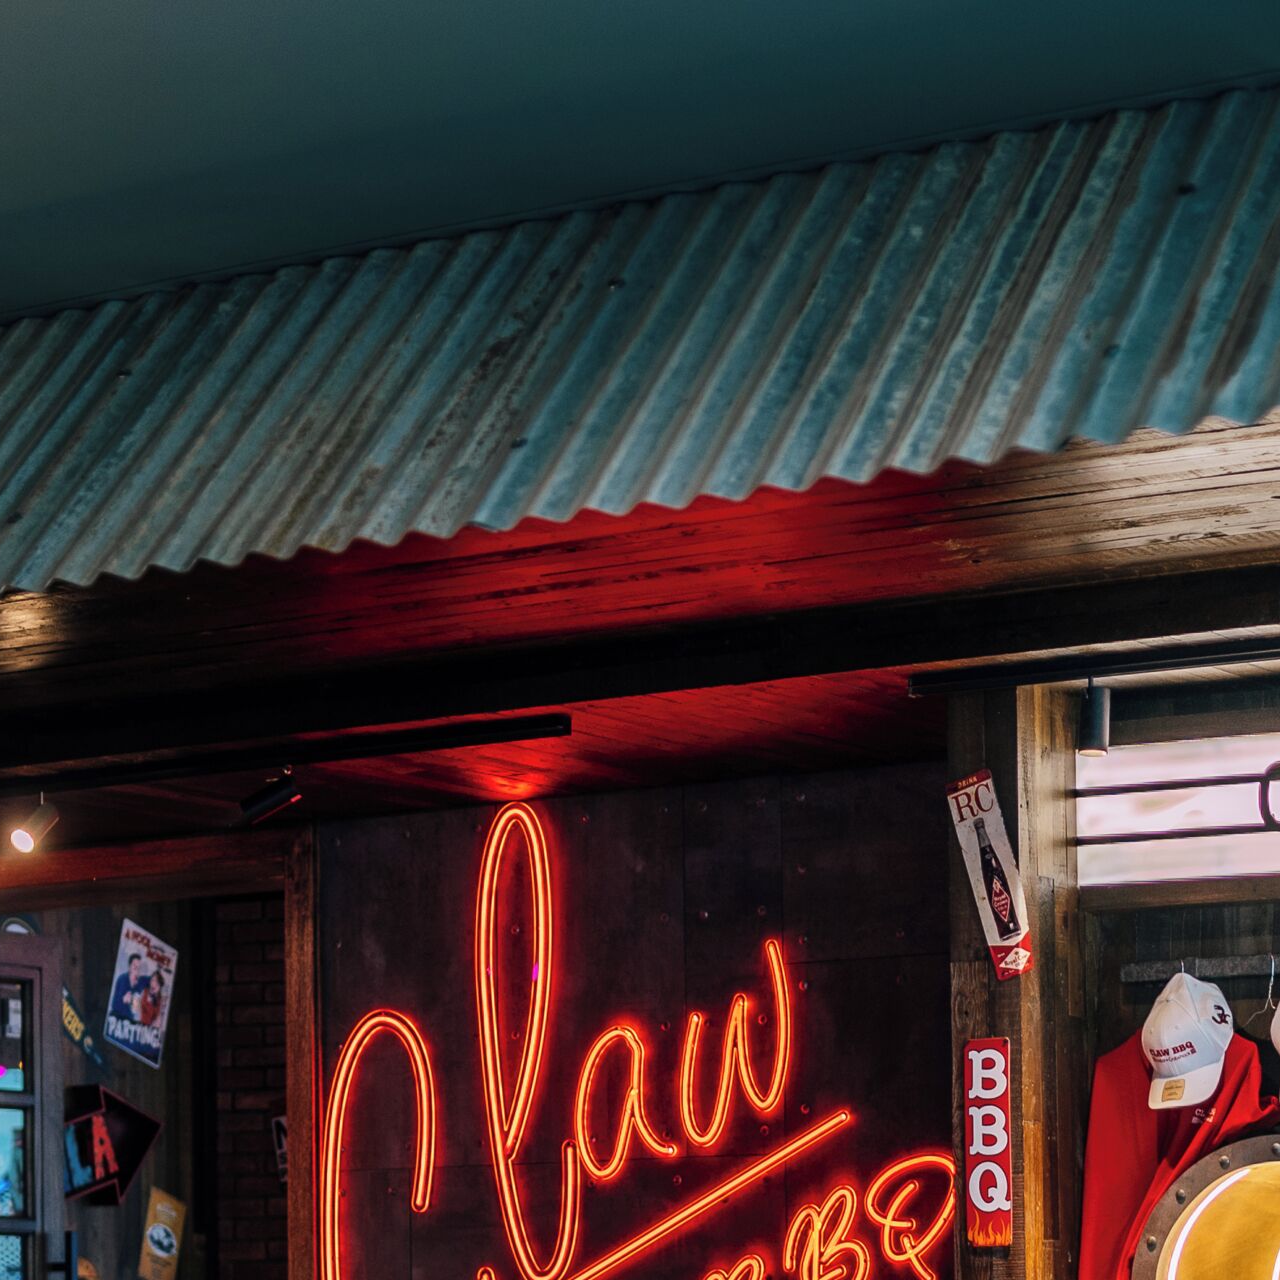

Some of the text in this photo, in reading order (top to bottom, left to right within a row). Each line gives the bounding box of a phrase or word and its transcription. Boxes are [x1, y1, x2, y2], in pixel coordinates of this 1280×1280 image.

[952, 784, 994, 823] RC
[1172, 1040, 1195, 1053] BBQ
[967, 1049, 1012, 1212] BBQ
